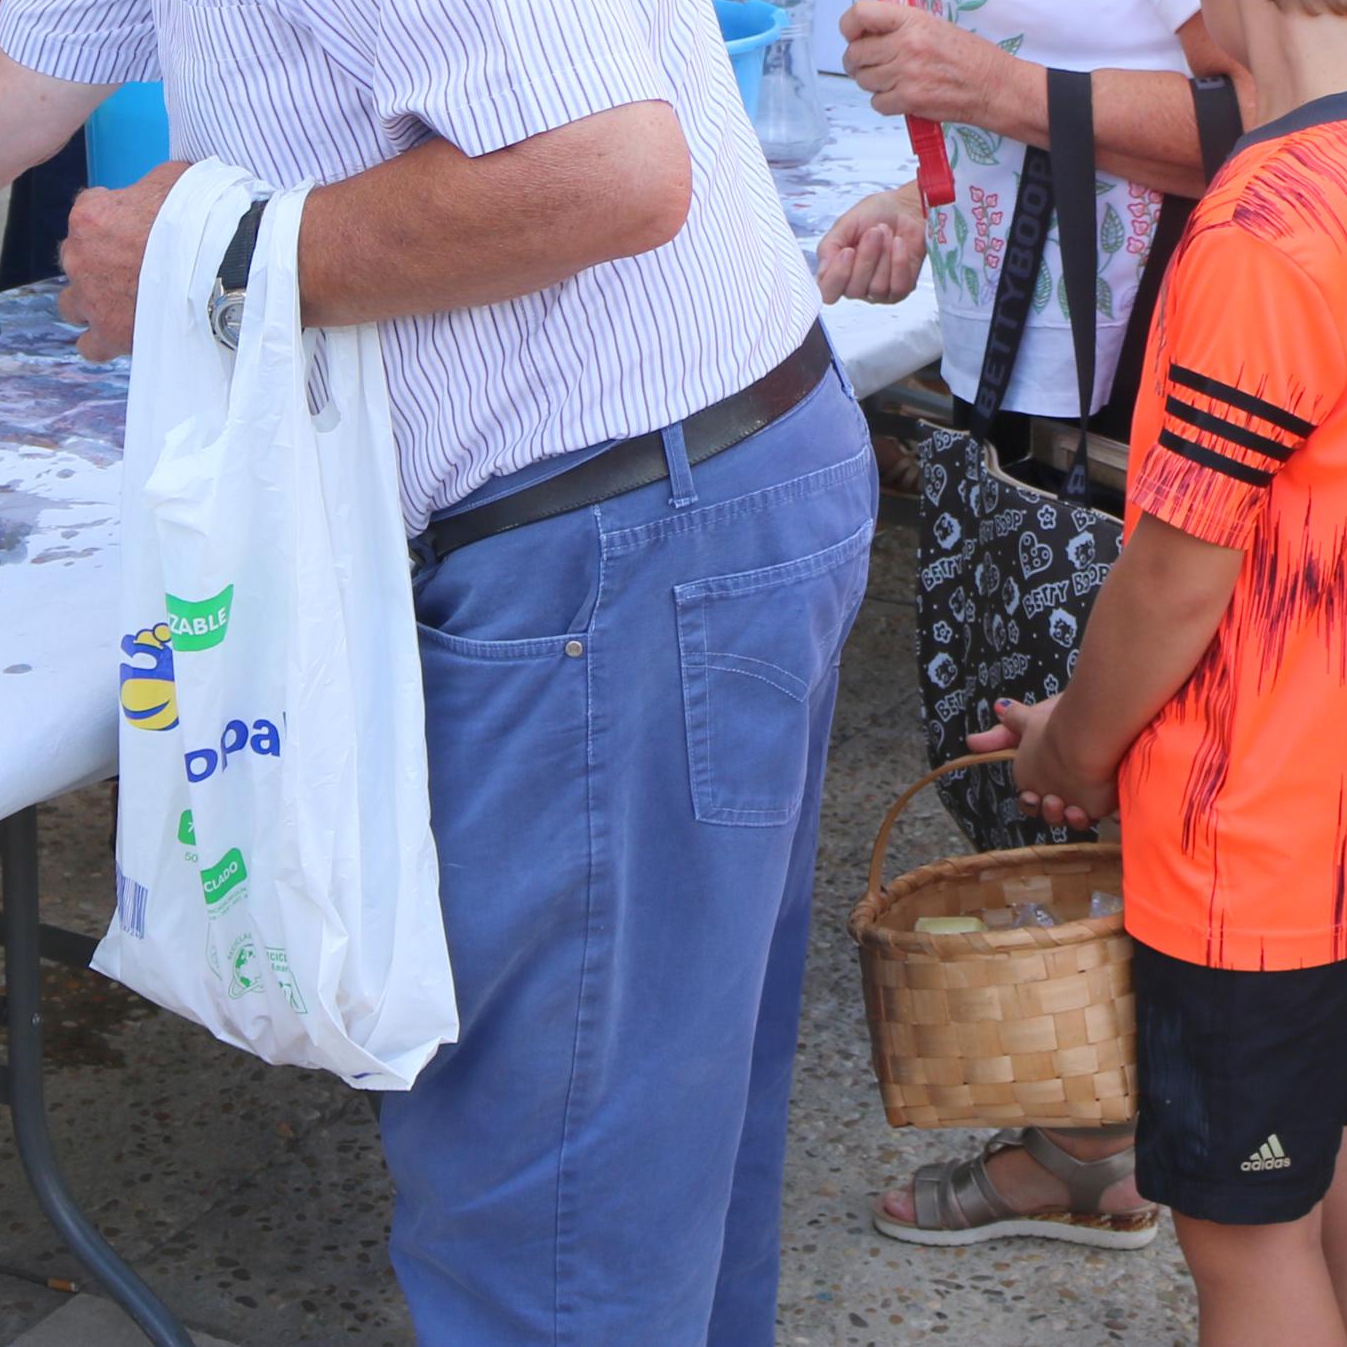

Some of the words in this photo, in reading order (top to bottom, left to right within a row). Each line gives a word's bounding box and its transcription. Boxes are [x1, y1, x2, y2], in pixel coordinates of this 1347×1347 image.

[921, 554, 963, 592] BETTY
[1022, 580, 1070, 620] BETTY
[168, 607, 228, 636] ZABLE
[1240, 1156, 1292, 1172] adidas
